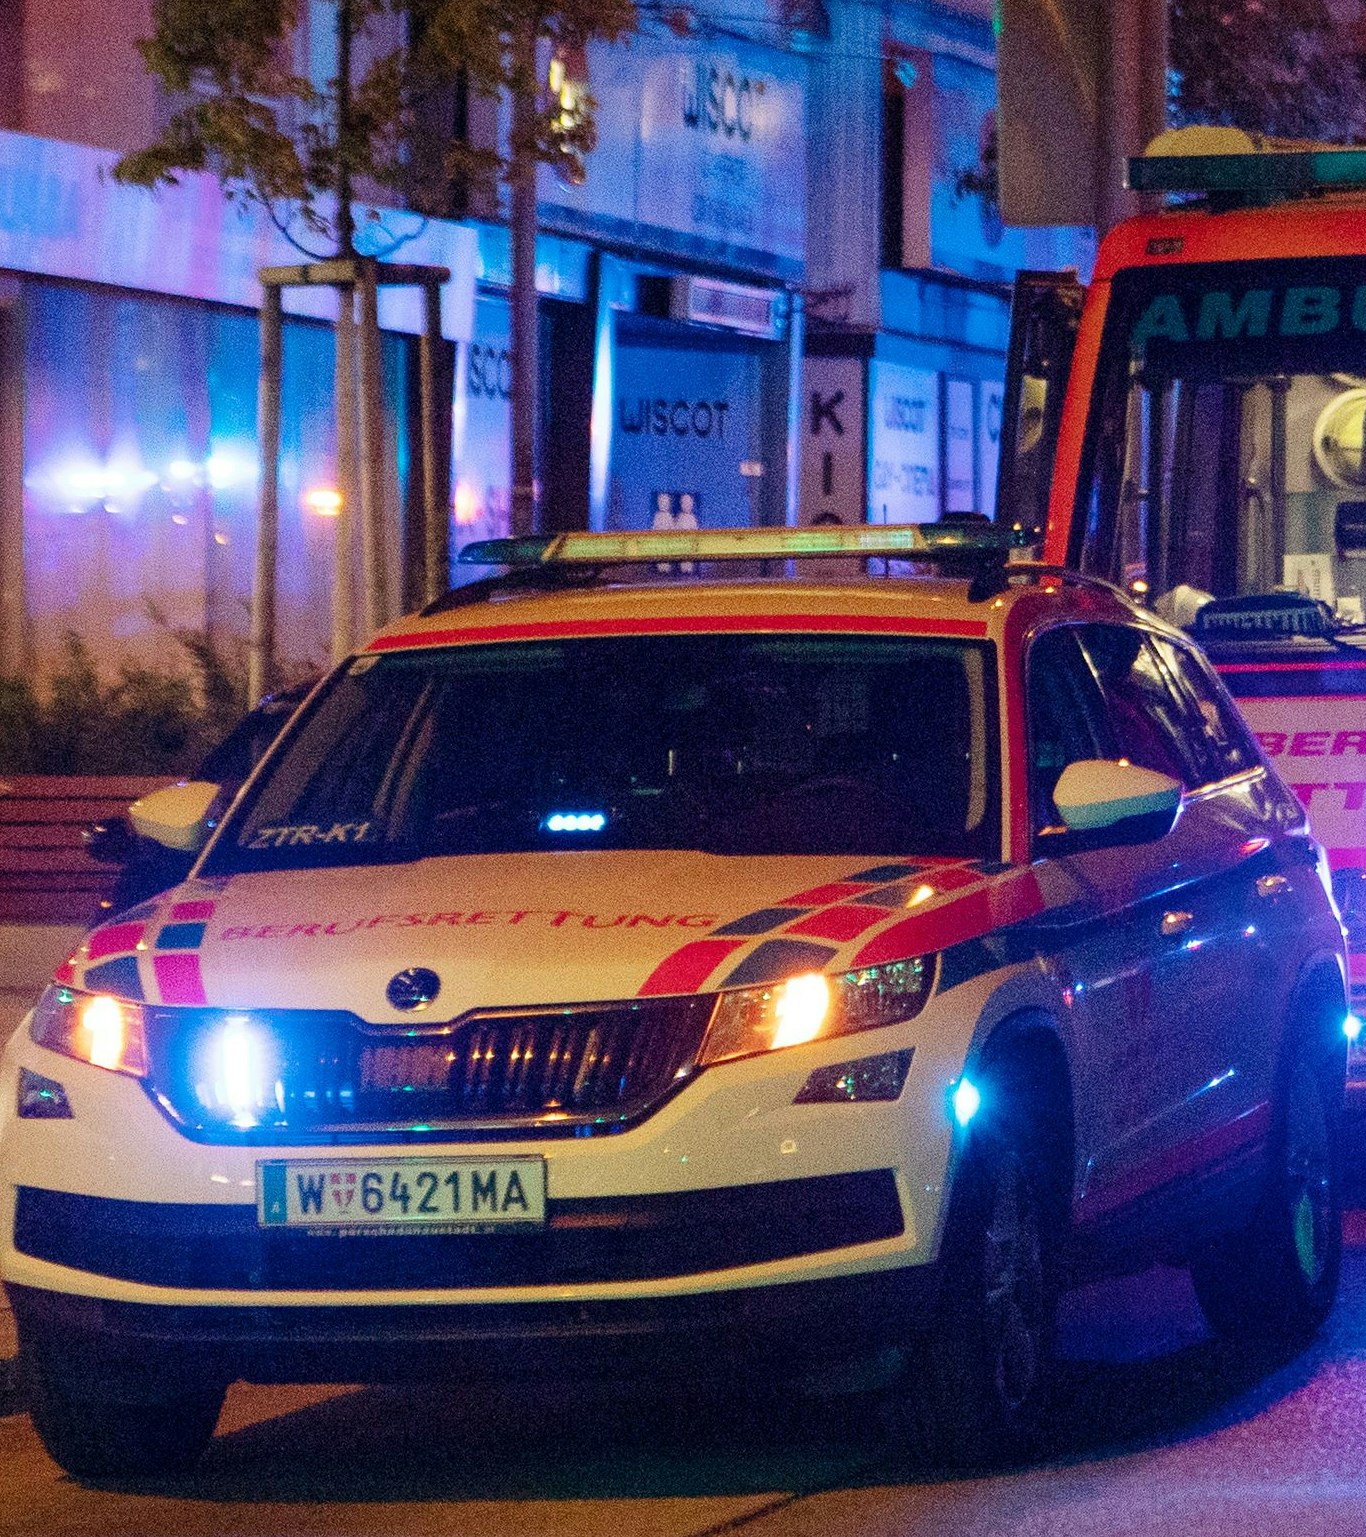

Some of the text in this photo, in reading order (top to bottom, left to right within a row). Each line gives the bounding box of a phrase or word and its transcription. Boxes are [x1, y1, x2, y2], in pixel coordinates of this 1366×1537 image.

[620, 398, 730, 438] WISCOT
[246, 821, 370, 849] ZTR-K1
[219, 909, 719, 941] BERUFSRETTUNG
